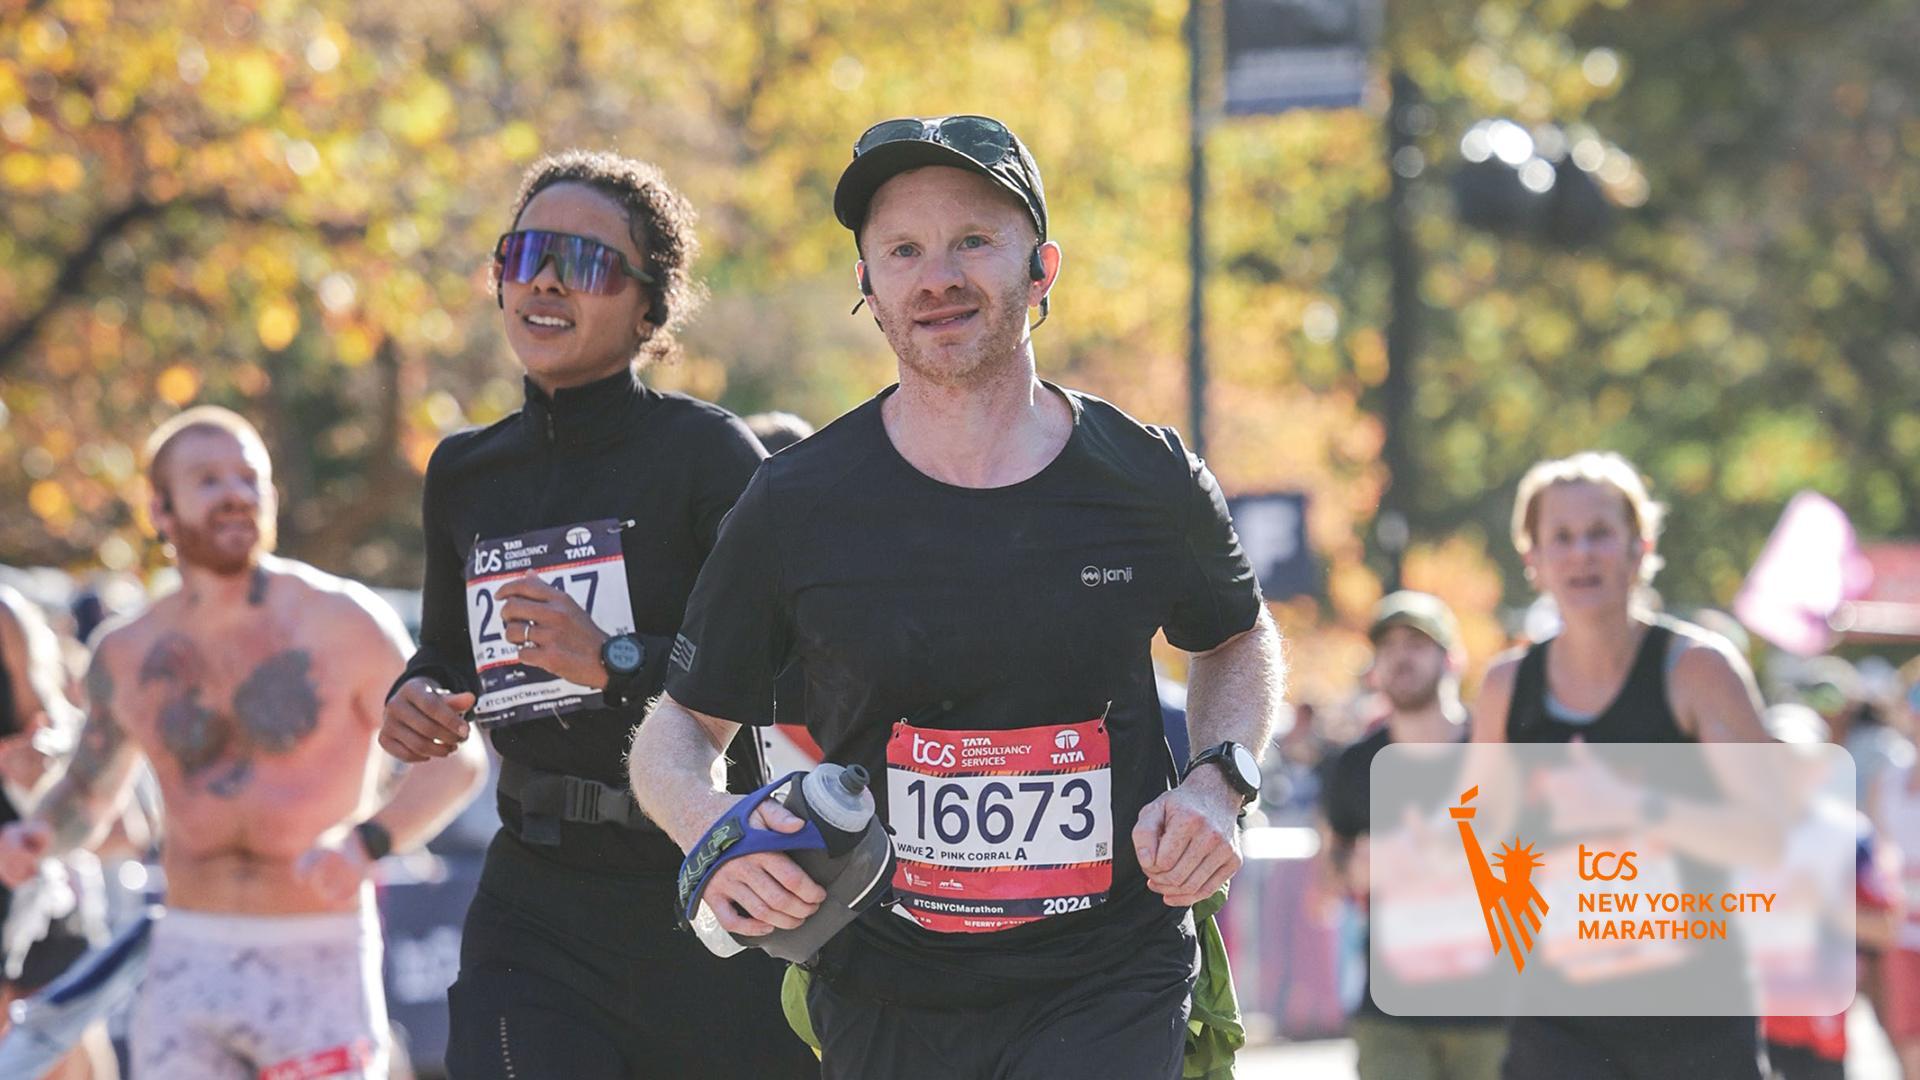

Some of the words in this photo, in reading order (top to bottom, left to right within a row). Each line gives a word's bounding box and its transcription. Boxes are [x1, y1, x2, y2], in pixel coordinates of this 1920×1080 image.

[565, 545, 596, 559] TATA
[1103, 567, 1133, 584] janji
[486, 647, 495, 659] 2
[962, 738, 991, 746] TATA
[912, 733, 956, 768] tcs
[961, 745, 1032, 757] CONSULTANCY
[961, 757, 1006, 767] SERVICES
[1051, 751, 1085, 765] TATA
[908, 779, 1095, 845] 16673
[897, 843, 924, 856] WAVE
[925, 846, 935, 860] 2
[941, 851, 965, 861] PINK
[967, 851, 1012, 861] CORRAL
[1014, 847, 1028, 861] A
[913, 898, 1004, 914] #TCSNYCMarathon
[1043, 896, 1092, 915] 2024
